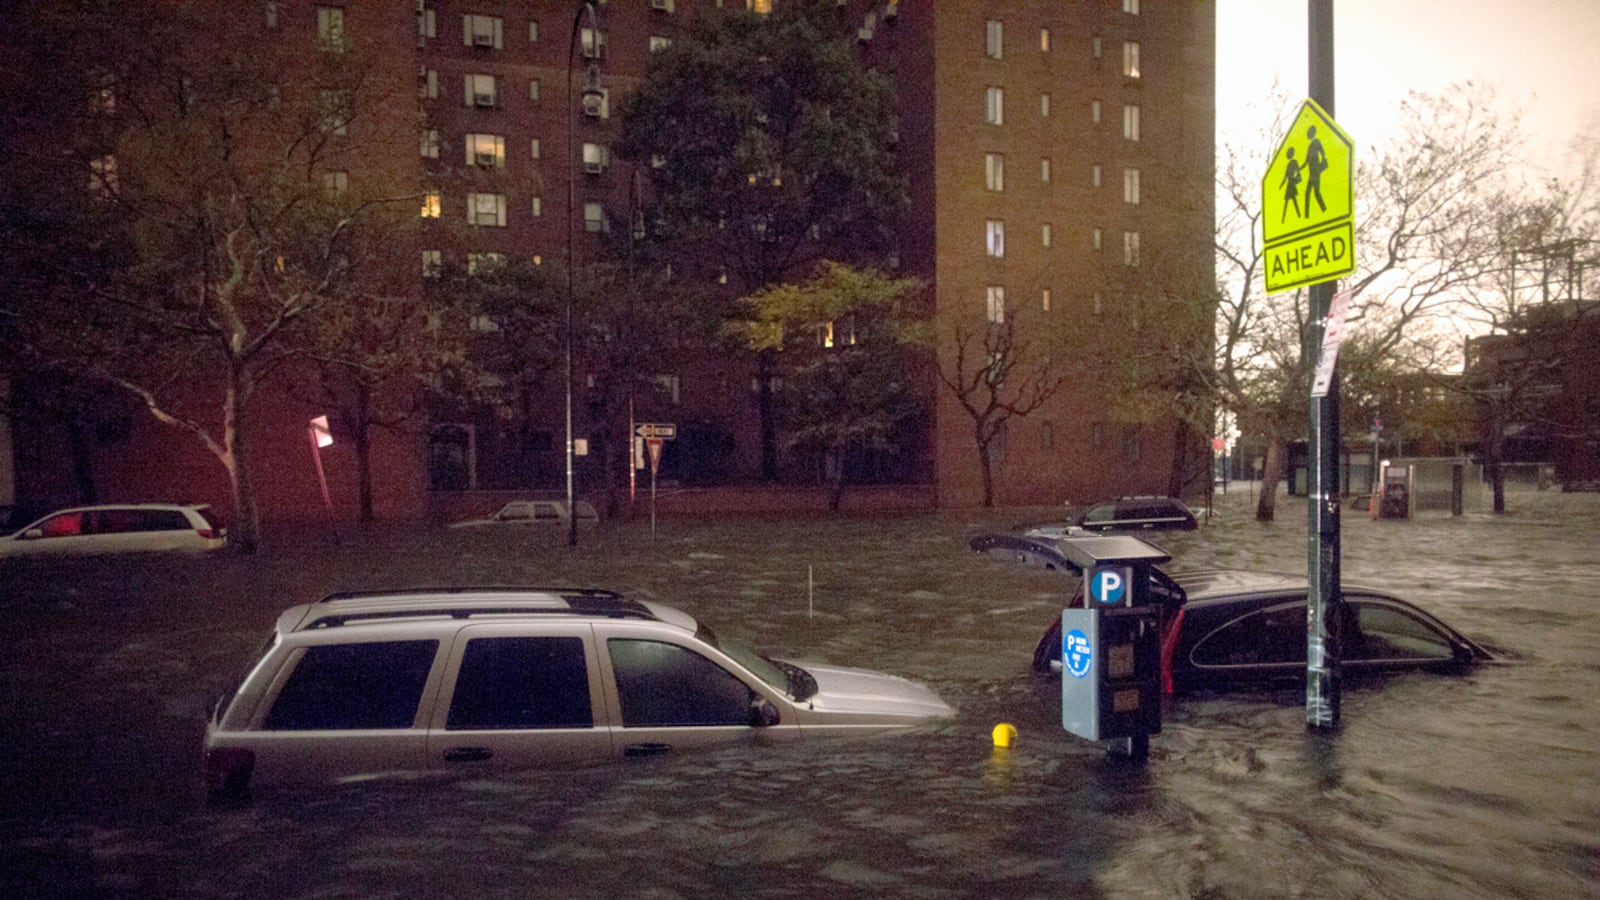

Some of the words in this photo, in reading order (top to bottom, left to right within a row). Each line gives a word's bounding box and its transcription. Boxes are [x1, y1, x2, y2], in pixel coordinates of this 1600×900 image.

[1272, 236, 1346, 278] AHEAD
[1101, 572, 1121, 601] P
[1067, 635, 1075, 650] P
